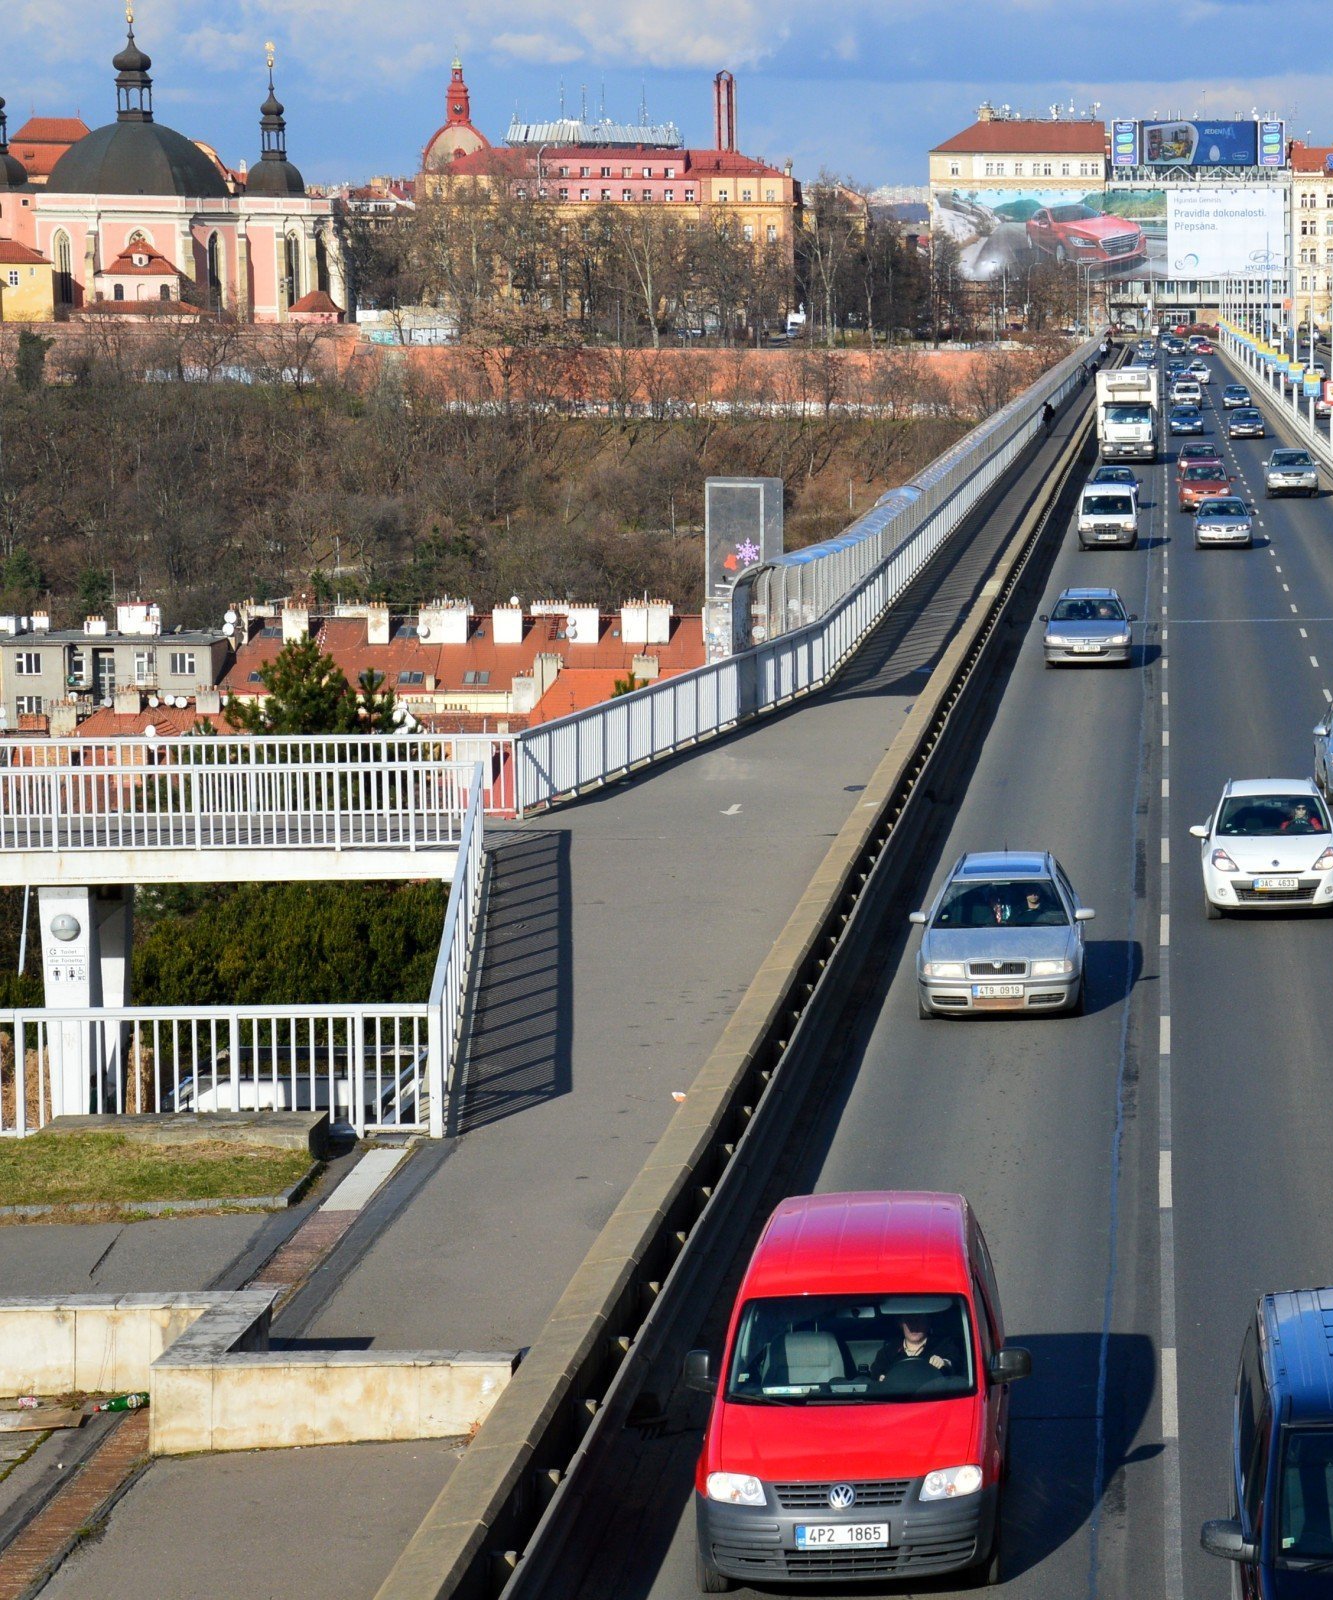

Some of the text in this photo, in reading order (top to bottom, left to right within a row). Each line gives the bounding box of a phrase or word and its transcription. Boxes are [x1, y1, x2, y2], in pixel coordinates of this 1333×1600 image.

[1174, 208, 1267, 218] Pravidla dokonalosti.
[1174, 221, 1218, 231] Přepsána.
[980, 985, 1020, 995] 4T9 0919
[809, 1526, 881, 1542] 4P2 1865
